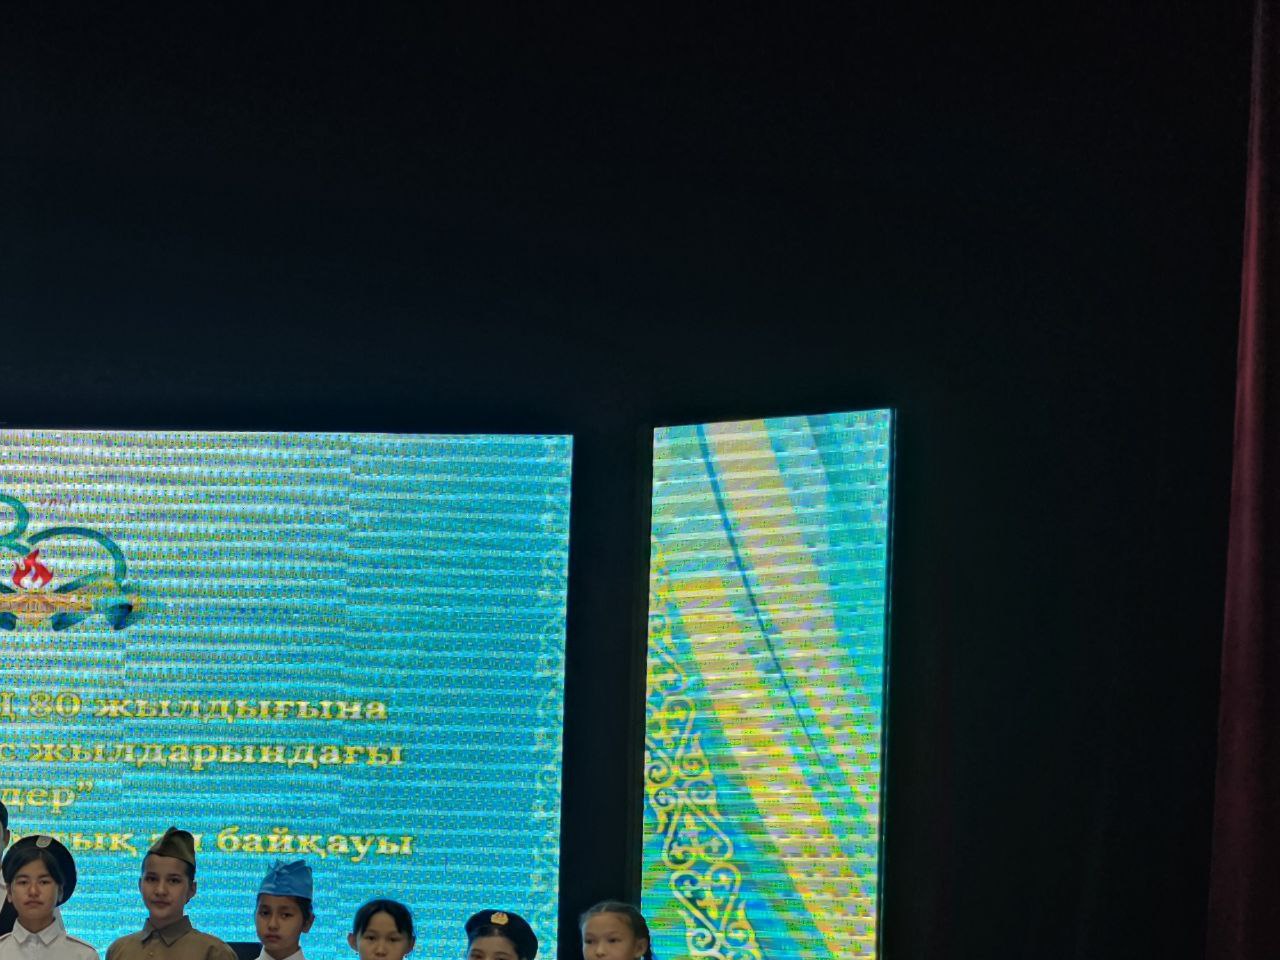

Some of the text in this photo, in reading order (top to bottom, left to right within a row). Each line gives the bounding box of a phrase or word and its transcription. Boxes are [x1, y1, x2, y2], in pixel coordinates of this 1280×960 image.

[28, 692, 82, 718] 80
[95, 698, 389, 723] жылдығына
[28, 742, 404, 771] жылдарындағы
[216, 825, 414, 862] байқауы
